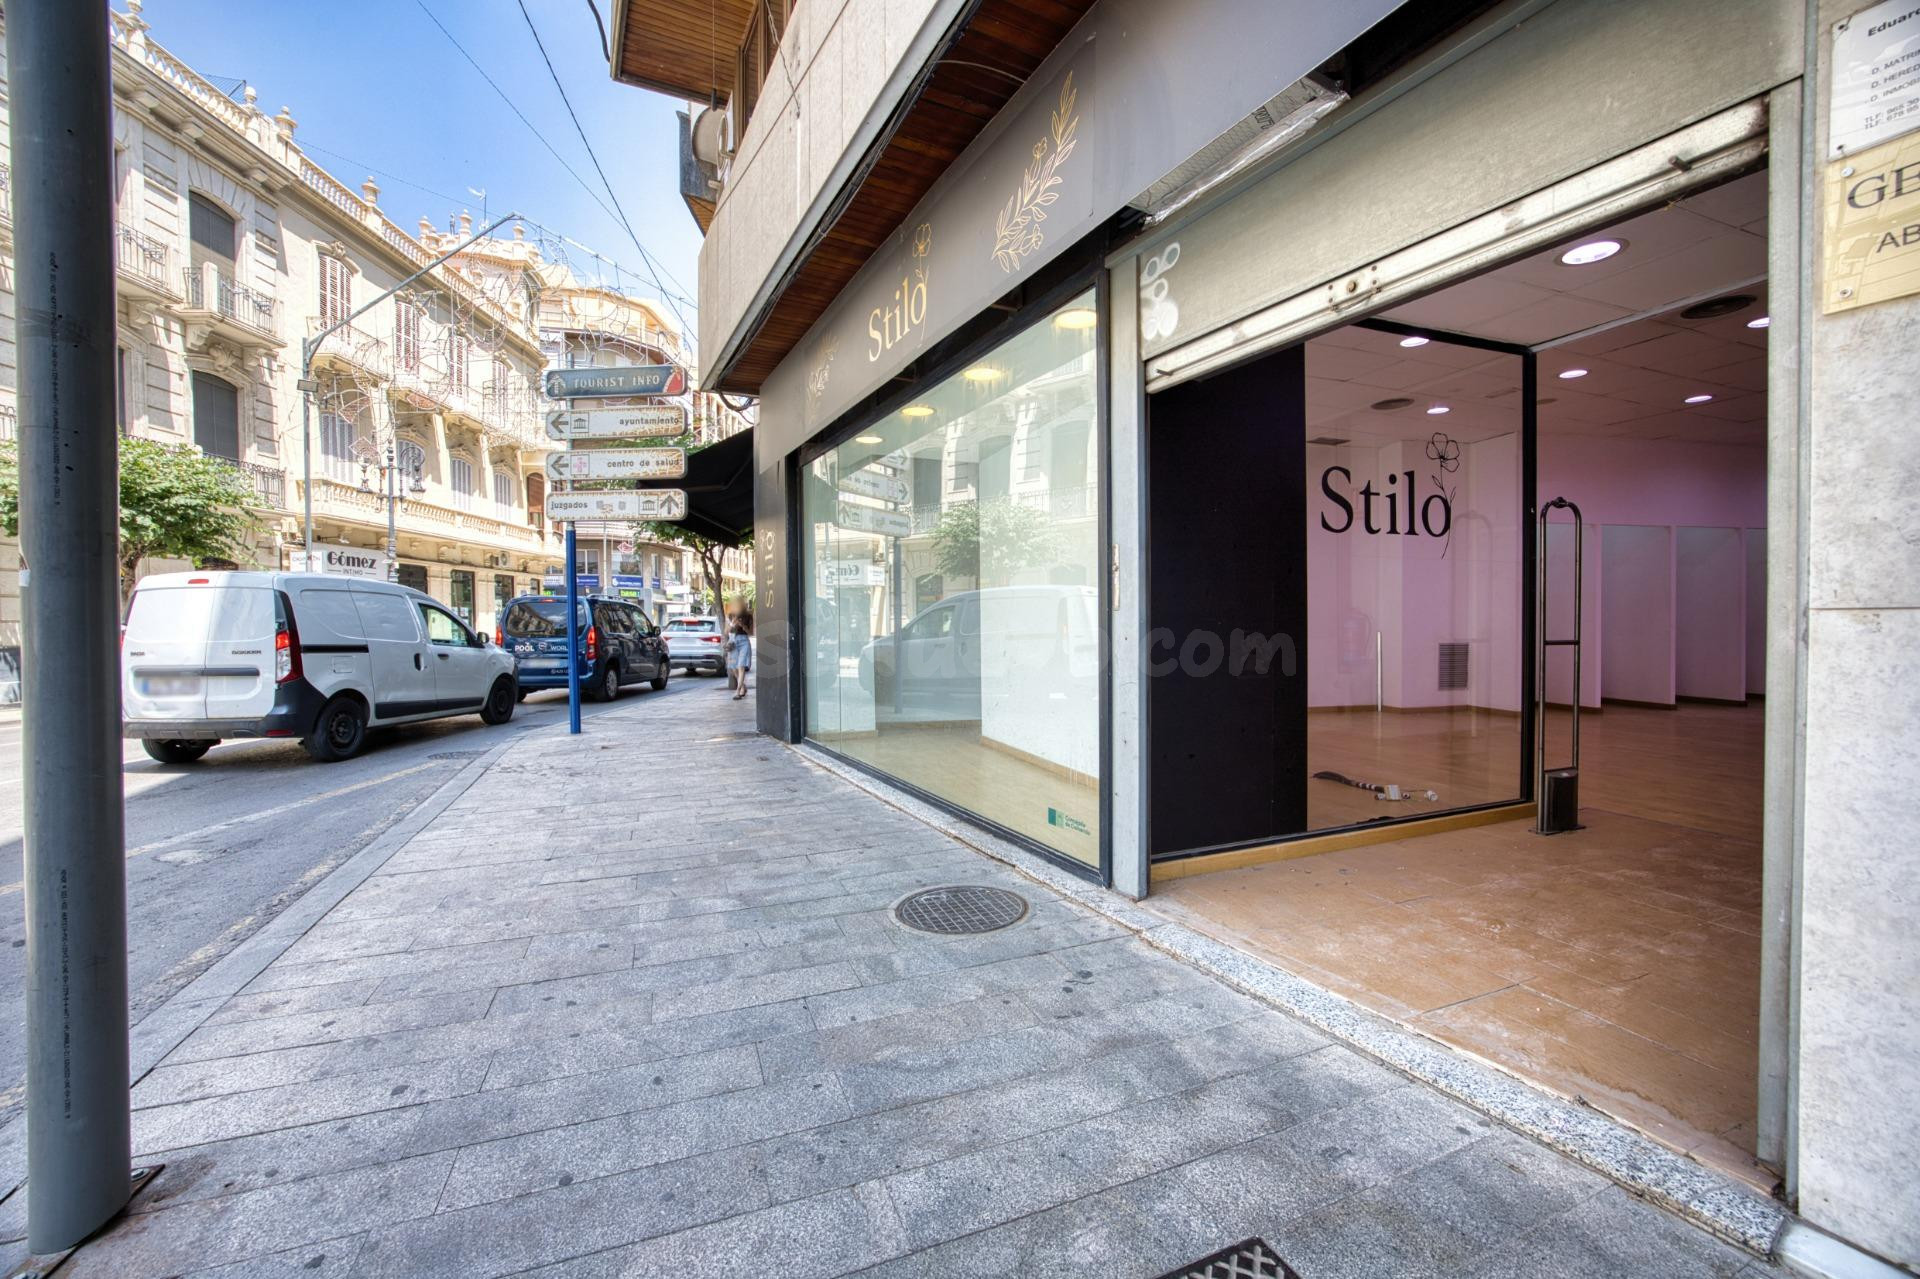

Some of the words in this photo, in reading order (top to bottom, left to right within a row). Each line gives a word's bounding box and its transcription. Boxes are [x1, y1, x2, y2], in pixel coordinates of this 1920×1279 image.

[868, 277, 927, 362] Stilo
[573, 376, 625, 389] TOURIST
[632, 374, 660, 387] INFO
[619, 416, 680, 426] ayuntamiento
[607, 460, 634, 468] centro
[639, 459, 650, 467] de
[655, 458, 680, 466] salud
[550, 501, 589, 511] juzgados
[1320, 465, 1452, 538] Stilo
[327, 551, 377, 569] Gómez
[550, 644, 569, 652] WORL
